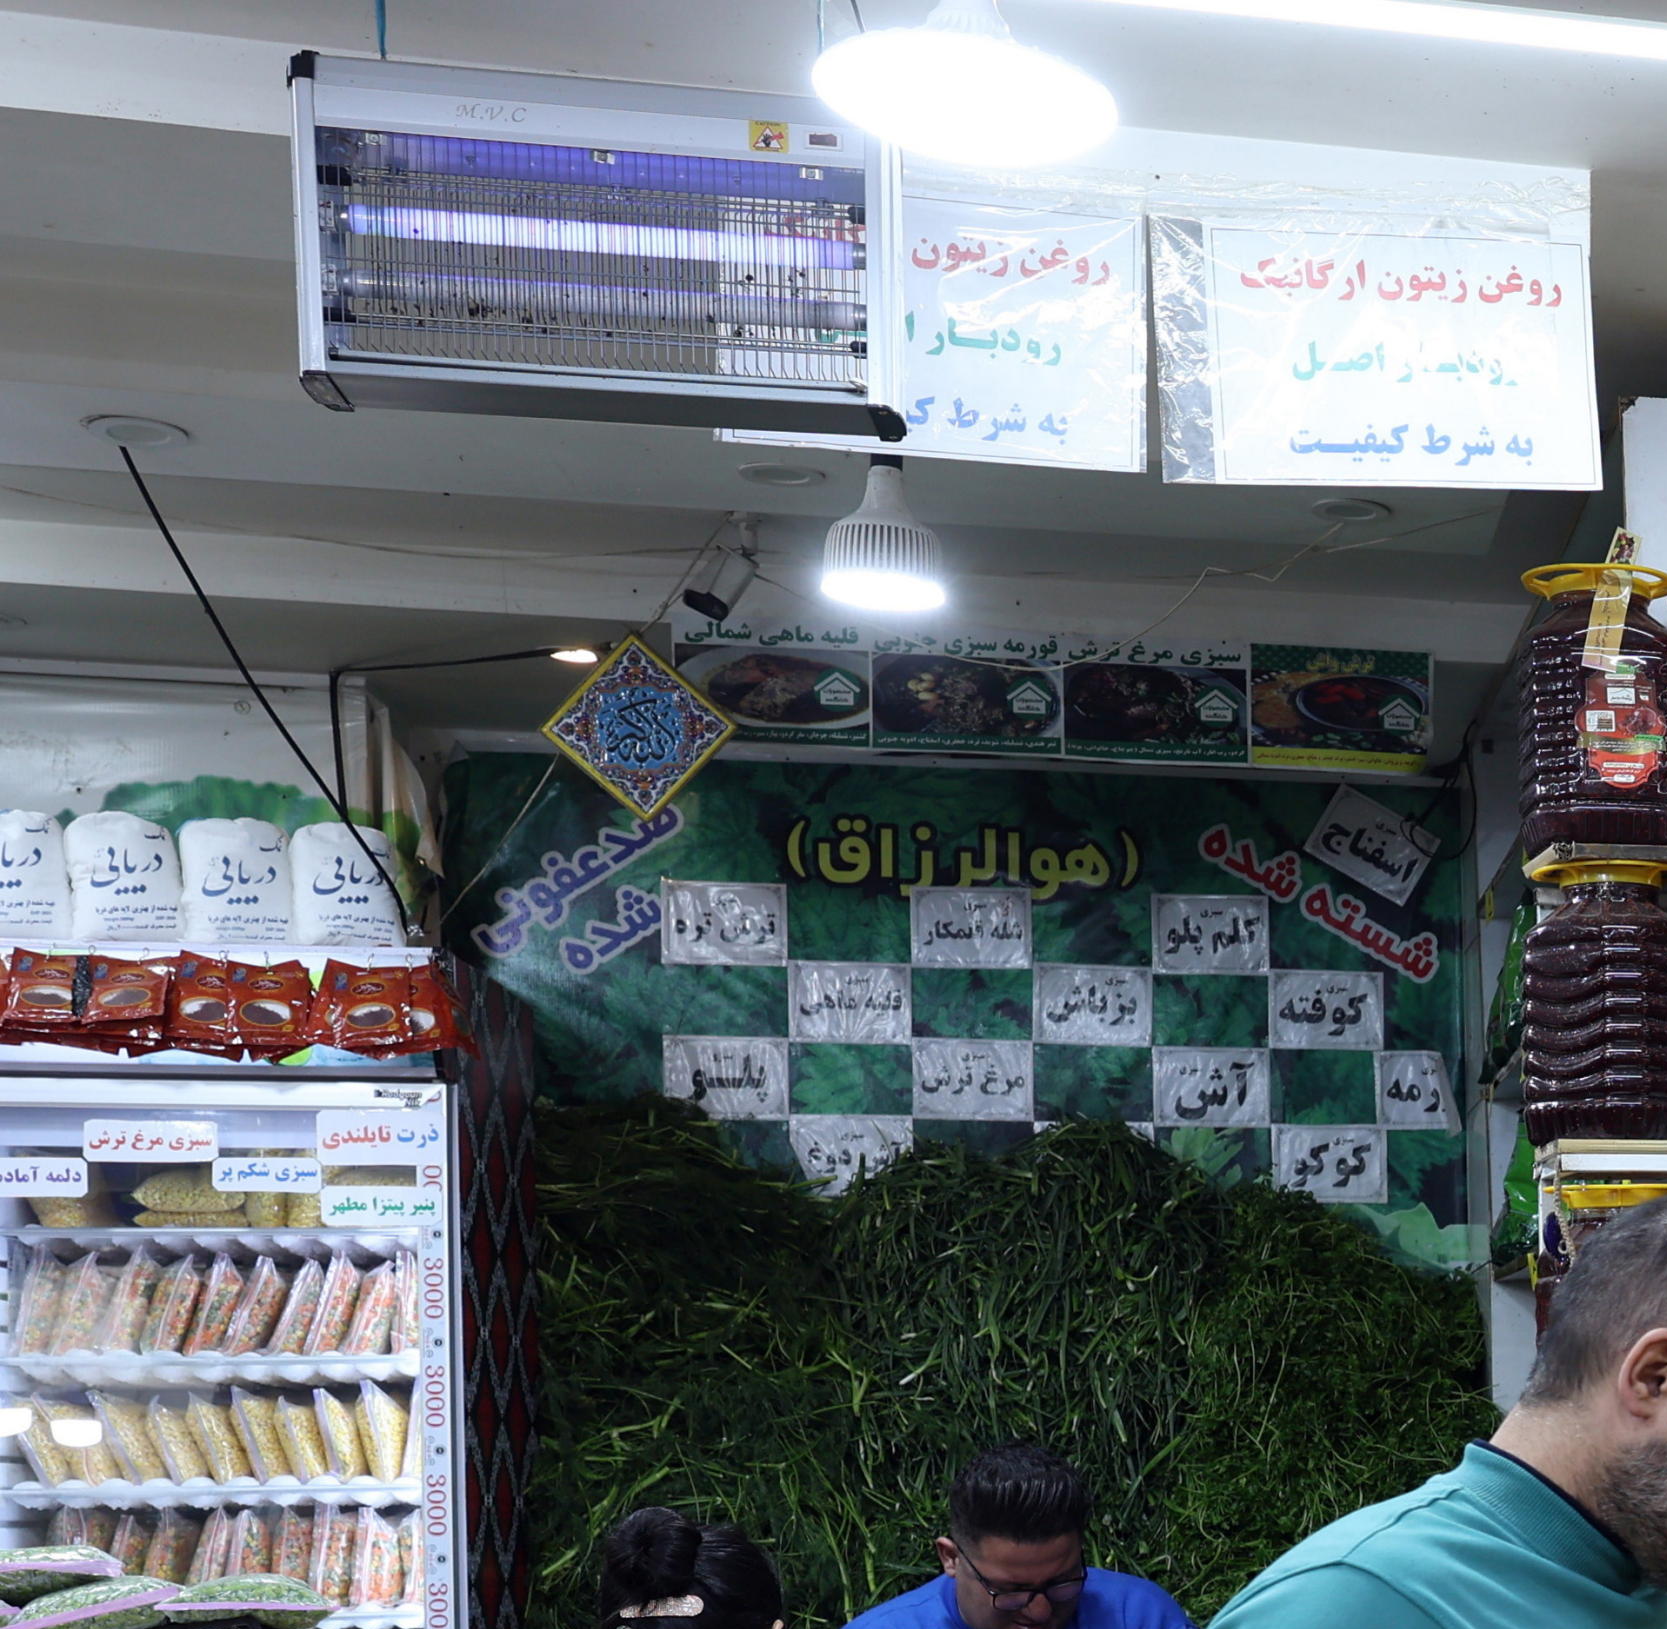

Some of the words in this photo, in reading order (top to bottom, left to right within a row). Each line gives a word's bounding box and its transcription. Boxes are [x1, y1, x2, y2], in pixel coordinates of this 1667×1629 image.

[911, 237, 1009, 277] زیتون
[1020, 240, 1111, 285] روغن
[1241, 257, 1366, 302] ارگانیک
[1377, 265, 1468, 304] زیتون
[1478, 264, 1562, 308] روغن
[948, 397, 1026, 441] شرط
[1290, 424, 1409, 463] کیفیت
[1421, 424, 1495, 466] شرط
[1505, 434, 1534, 467] به
[684, 621, 752, 644] شمالی
[758, 625, 814, 646] ماهی
[821, 626, 860, 646] قلیه
[943, 634, 998, 656] سبزی
[1003, 633, 1059, 660] قورمه
[1127, 642, 1173, 665] مرغ
[1180, 649, 1242, 667] سبزی
[1203, 829, 1297, 898] شده
[1321, 823, 1418, 883] اسفناج
[565, 889, 661, 969] شده
[1305, 888, 1434, 979] شسته
[800, 988, 858, 1016] ماهی
[865, 987, 903, 1015] قلیه
[1279, 989, 1368, 1036] کوفته
[921, 1064, 974, 1094] ترش
[980, 1062, 1025, 1095] مرغ
[1174, 1061, 1254, 1119] آش
[89, 1129, 127, 1150] ترش
[131, 1131, 166, 1153] مرغ
[169, 1132, 213, 1153] سبزی
[321, 1126, 393, 1150] تایلندی
[397, 1126, 440, 1149] ذرت
[46, 1166, 82, 1184] دلمه
[218, 1168, 235, 1186] پر
[237, 1161, 274, 1181] شکم
[278, 1164, 319, 1183] سبزی
[328, 1197, 369, 1216] مطهر
[370, 1194, 406, 1216] پیتزا
[407, 1198, 436, 1216] پنیر
[424, 1256, 445, 1321] 3000
[425, 1364, 446, 1429] 3000
[426, 1473, 447, 1538] 3000
